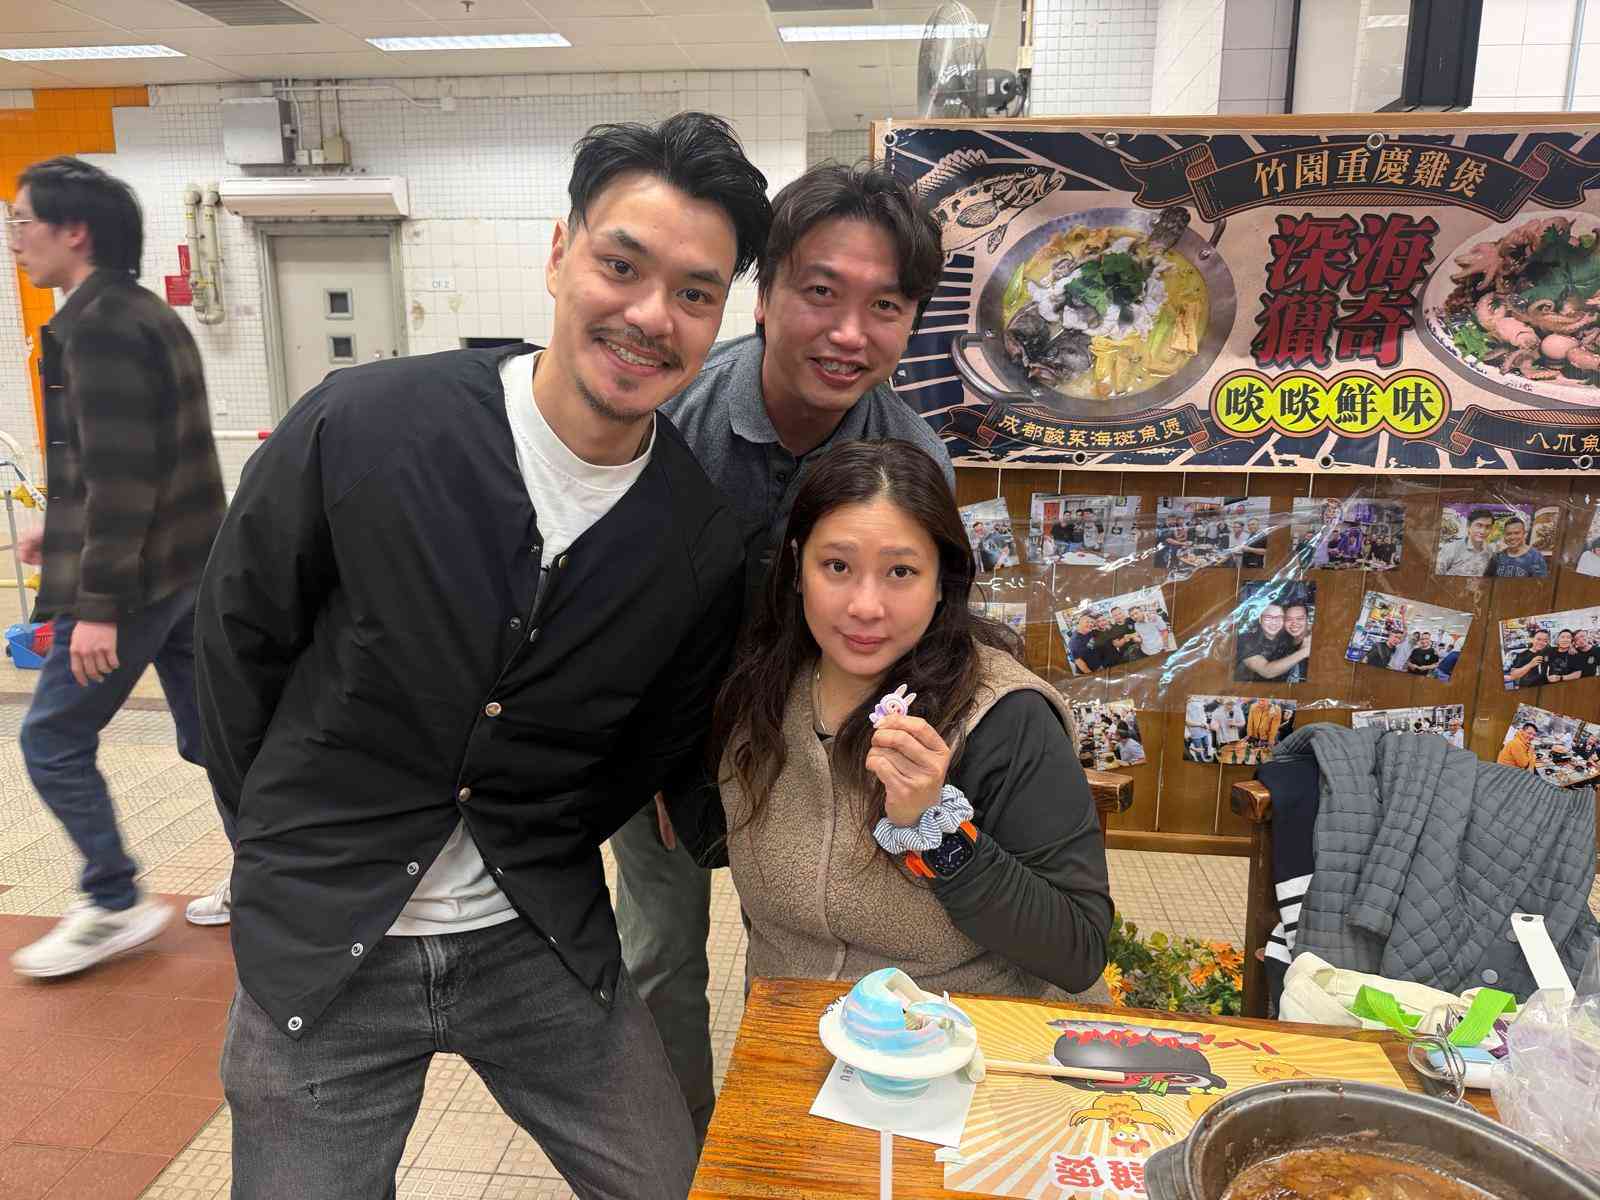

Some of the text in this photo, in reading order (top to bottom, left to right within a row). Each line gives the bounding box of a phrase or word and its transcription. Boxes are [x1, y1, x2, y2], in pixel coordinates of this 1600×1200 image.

[1254, 147, 1488, 198] 竹園重慶雞煲
[1266, 213, 1440, 295] 深海
[1251, 290, 1416, 370] 獵奇
[1224, 382, 1436, 426] 啖啖鮮味
